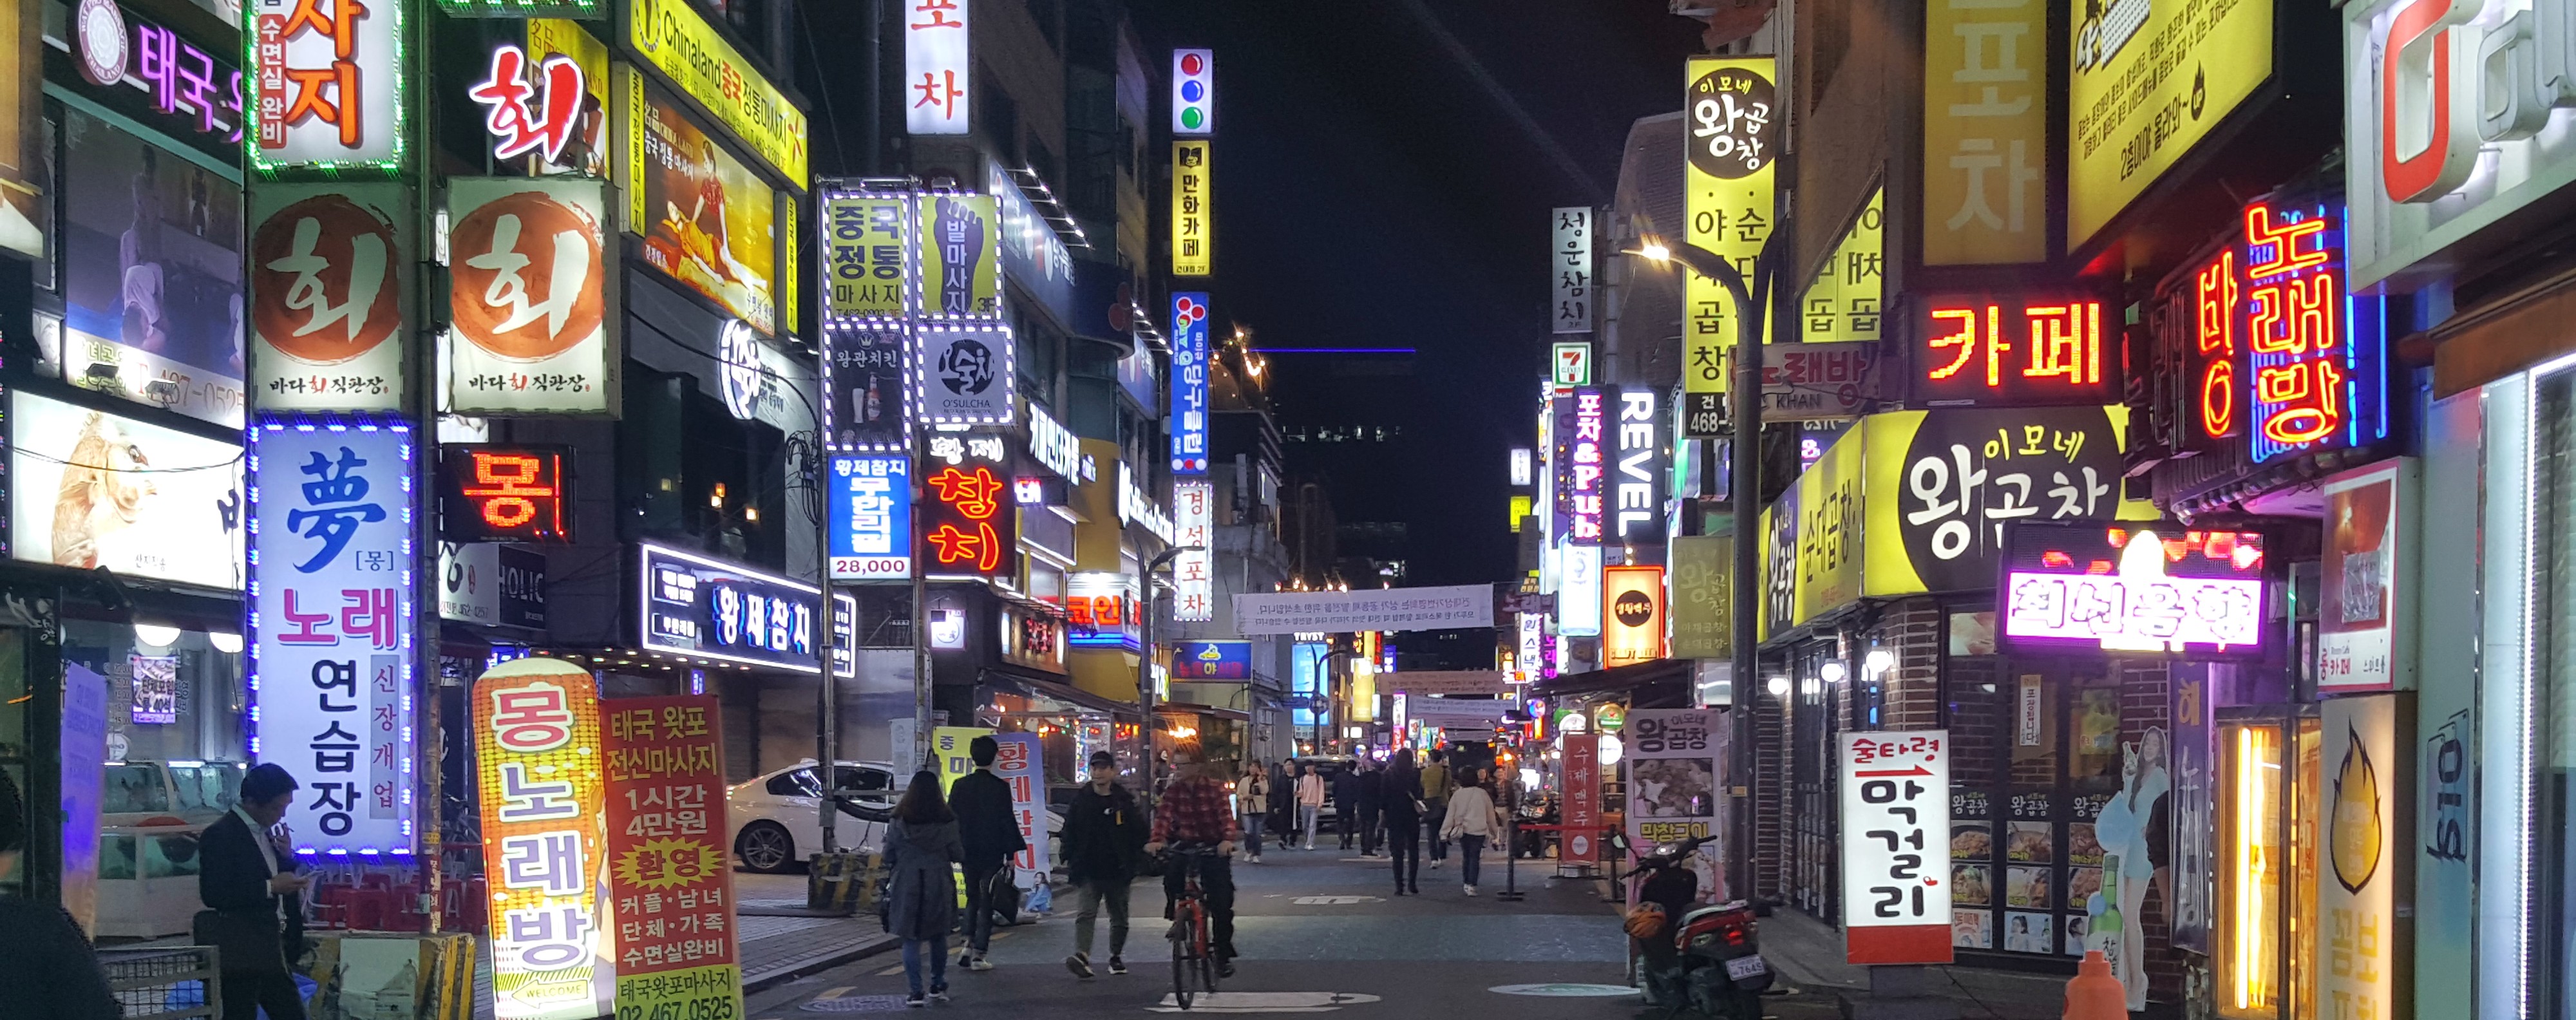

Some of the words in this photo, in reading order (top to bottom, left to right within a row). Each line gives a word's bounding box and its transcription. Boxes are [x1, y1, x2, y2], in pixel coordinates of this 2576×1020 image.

[138, 24, 217, 132] 태국
[261, 18, 283, 90] 수면실
[664, 10, 721, 90] Chinaland
[722, 60, 741, 109] 중국
[469, 45, 583, 163] 회
[1700, 76, 1753, 95] 이모네
[261, 98, 283, 145] 완비
[1694, 95, 1770, 171] 왕곱창
[1946, 21, 2038, 234] 포차
[645, 131, 658, 160] 중국
[660, 142, 674, 170] 정통
[674, 155, 694, 182] 마사지
[2120, 122, 2152, 182] 2층이야
[835, 206, 900, 240] 중국
[1182, 175, 1200, 258] 만화카페
[266, 216, 387, 343] 회
[465, 214, 589, 340] 회
[835, 245, 900, 280] 정통
[946, 221, 968, 314] 발마사지
[1558, 211, 1589, 321] 청운참치
[837, 283, 900, 305] 마사지
[2246, 204, 2342, 444] 노래방
[836, 349, 898, 368] 왕관치킨
[1929, 303, 2099, 386] 카페
[269, 377, 305, 393] 바다
[330, 377, 385, 394] 직판장
[469, 373, 506, 391] 바다
[531, 373, 585, 392] 직판장
[943, 399, 991, 408] O'SULCHA
[1184, 364, 1203, 453] 당구클럽
[1776, 393, 1821, 409] KHAN
[835, 460, 905, 477] 황제참치
[1573, 393, 1603, 540] 포차&Pub
[1618, 392, 1655, 537] REVEL
[1984, 424, 2086, 463] 이모네
[287, 446, 386, 574] 夢
[836, 560, 905, 575] 28,000
[1182, 489, 1206, 616] 경성포차
[278, 589, 401, 650] 노래
[715, 585, 810, 655] 황제참치
[1067, 595, 1121, 625] 코인
[309, 658, 362, 836] 연습장
[372, 663, 398, 809] 신장개업
[491, 682, 574, 752] 몽
[611, 709, 656, 742] 태국
[661, 706, 707, 740] 왓포
[1636, 717, 1709, 753] 왕곱창
[607, 743, 718, 782] 전신마사지
[1851, 737, 1940, 764] 술타령
[625, 784, 707, 810] 1시간
[625, 810, 708, 837] 4만원
[498, 762, 591, 970] 노래방
[636, 847, 703, 880] 환영
[1861, 780, 1926, 918] 막걸리
[622, 938, 724, 967] 수면실완비
[526, 985, 582, 998] WELCOME
[620, 968, 731, 998] 태국왓포마사지
